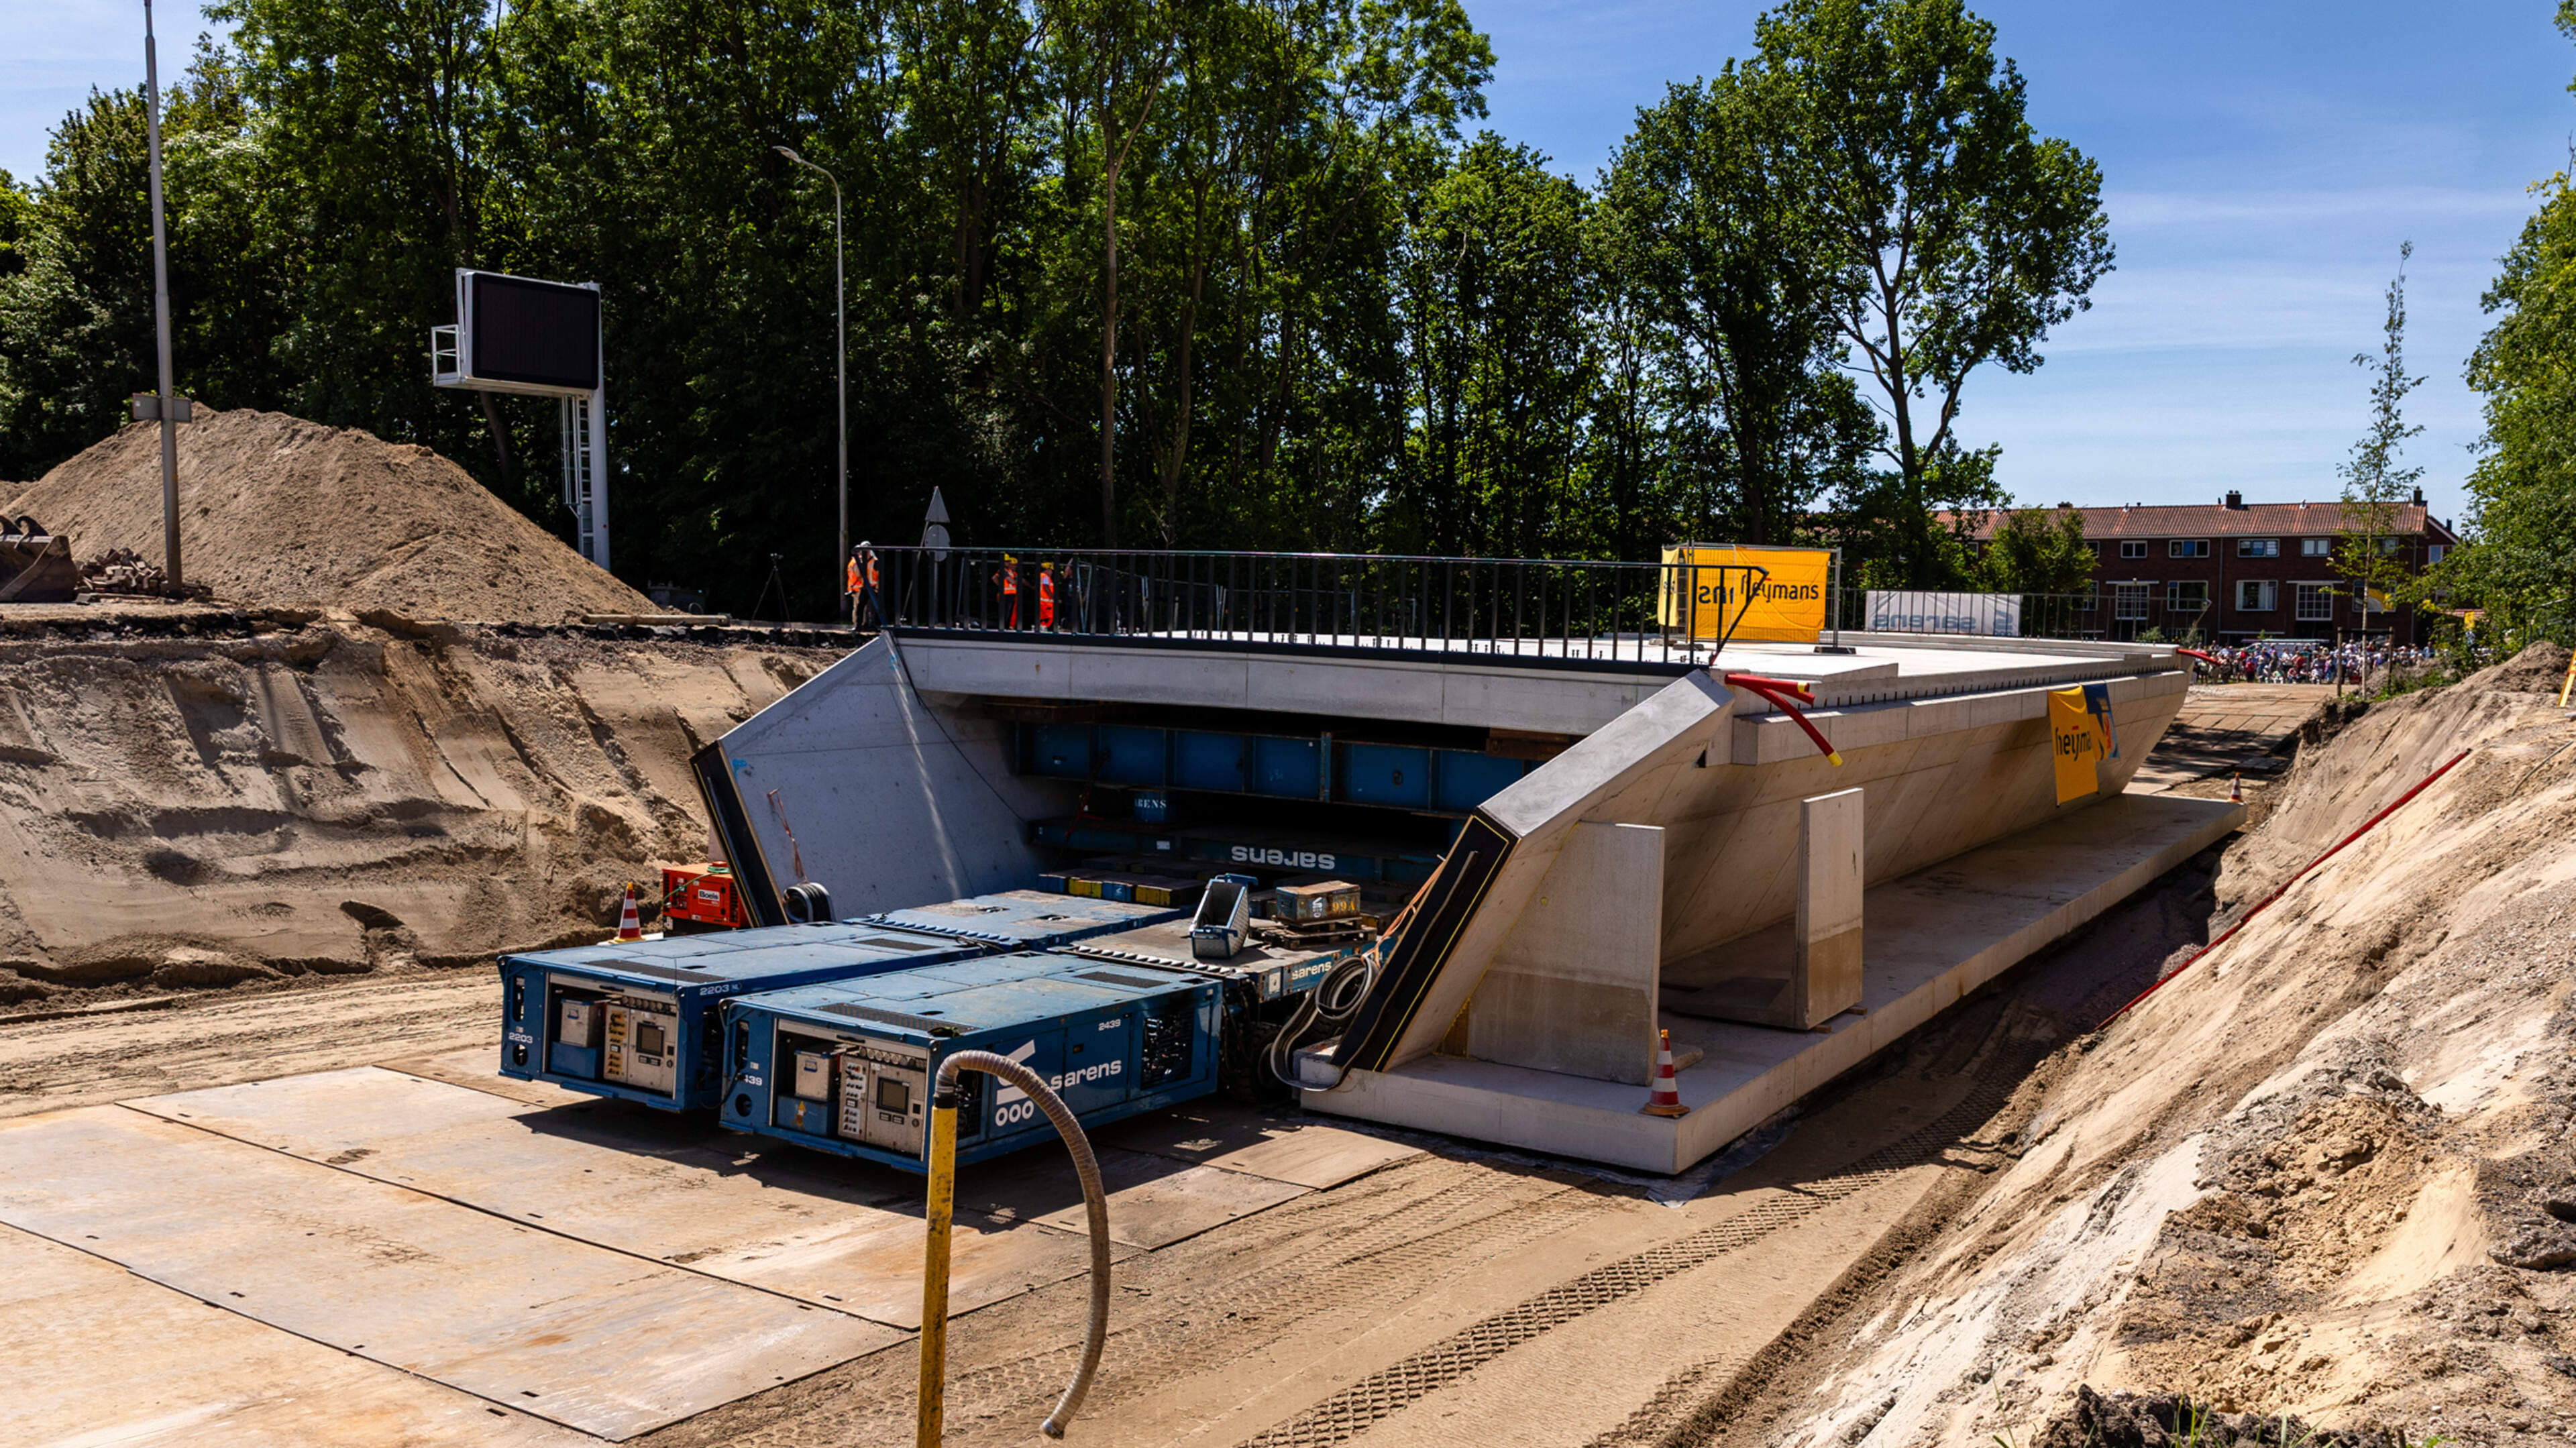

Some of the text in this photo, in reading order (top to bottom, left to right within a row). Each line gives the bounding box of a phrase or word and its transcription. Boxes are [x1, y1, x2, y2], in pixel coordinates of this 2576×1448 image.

[1231, 846, 1336, 870] sarens
[1292, 961, 1332, 980] sarens
[700, 984, 729, 996] 2203
[1098, 1019, 1122, 1031] 2439
[508, 1032, 533, 1044] 2203
[1050, 1060, 1122, 1091] sarens
